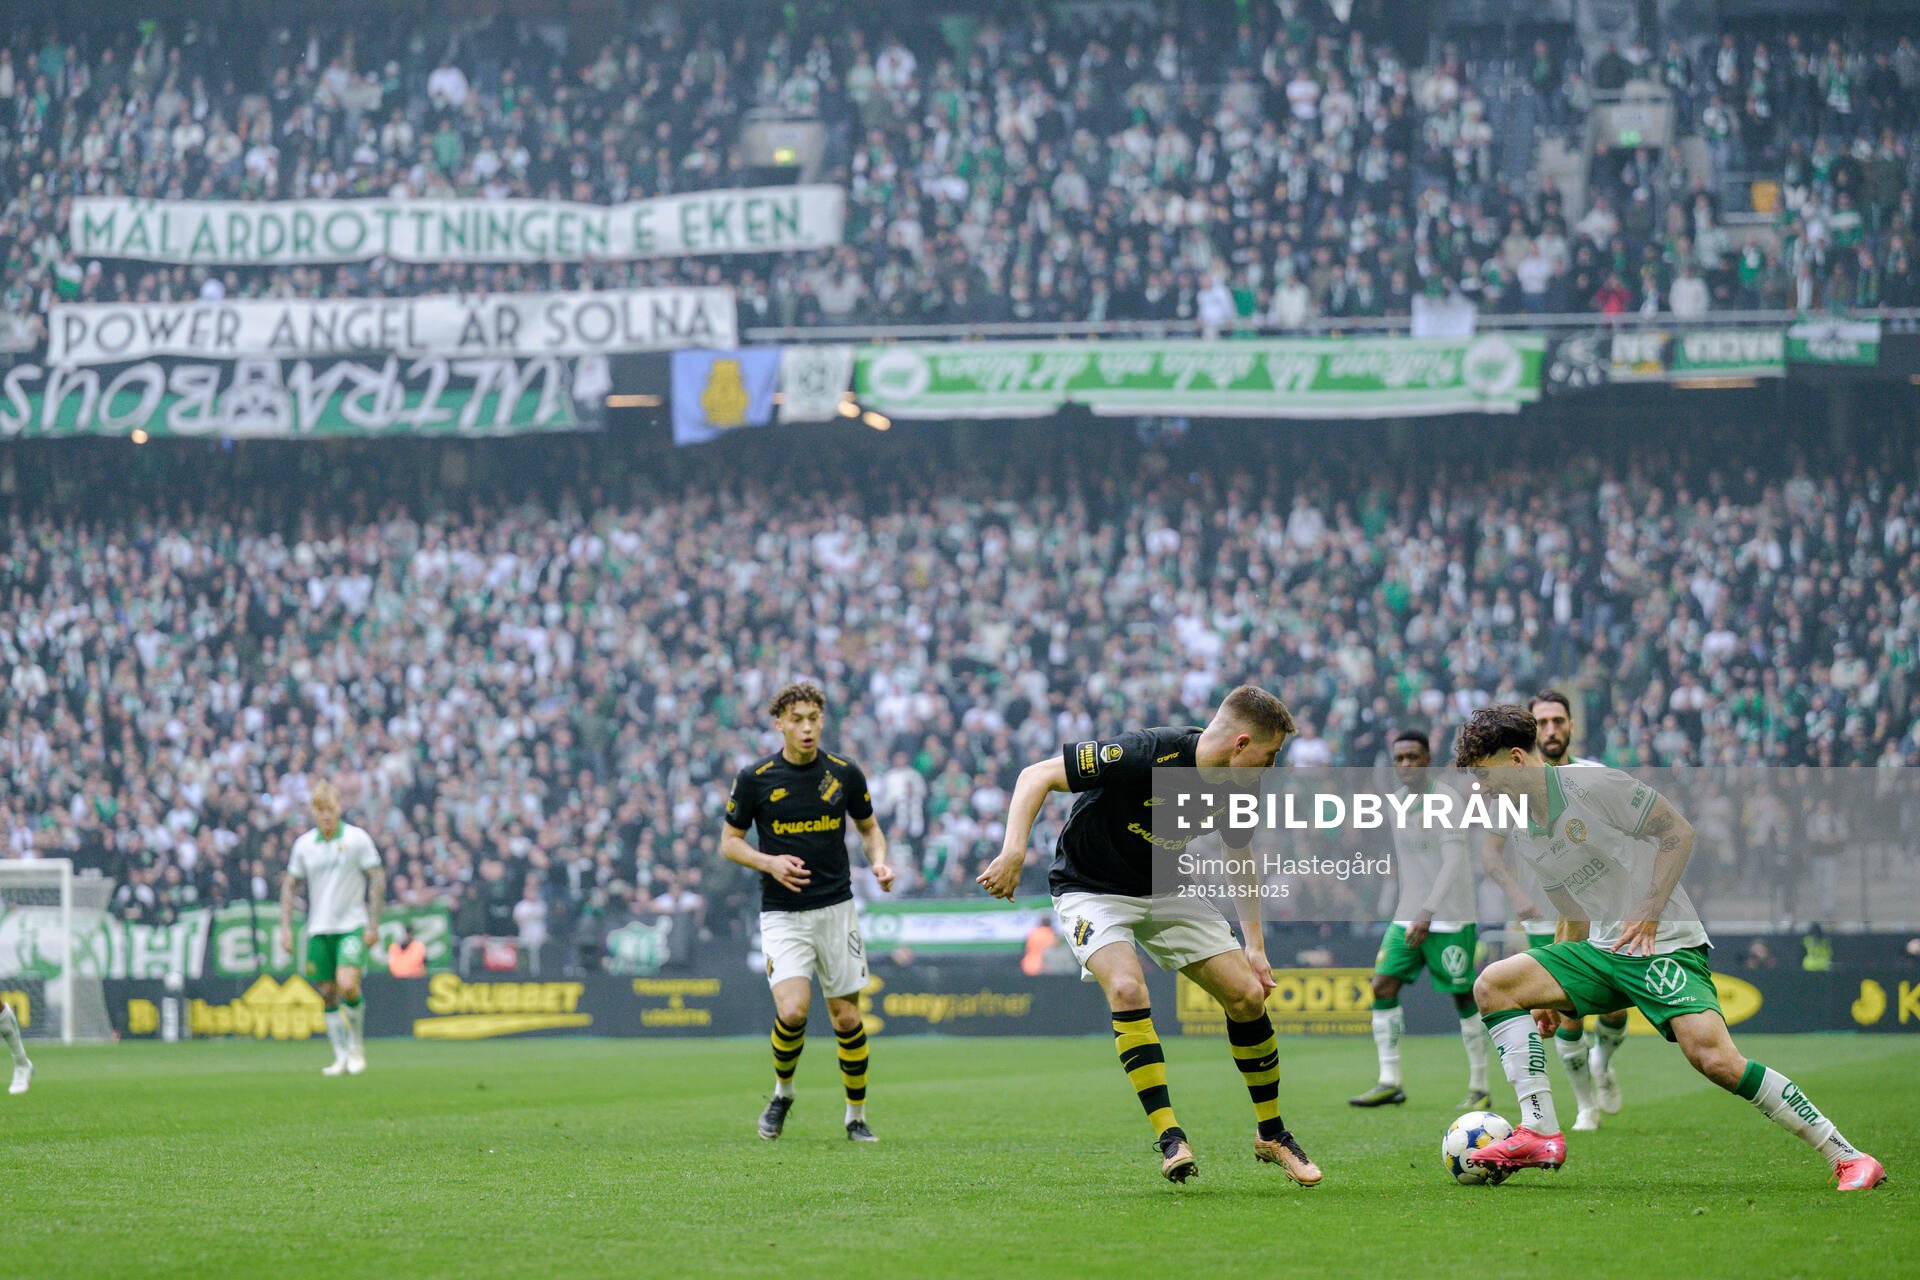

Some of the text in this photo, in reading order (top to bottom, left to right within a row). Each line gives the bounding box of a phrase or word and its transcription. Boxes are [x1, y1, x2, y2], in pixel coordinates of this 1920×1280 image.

[82, 198, 607, 256] MÄLARDROTTNINGEN
[633, 206, 657, 252] E
[63, 293, 713, 354] POWER ANGEL ÄR SOLNA
[287, 354, 563, 434] ULTRA
[1084, 743, 1096, 775] UNIBET
[771, 815, 842, 835] truecaller
[1127, 821, 1192, 852] truecall
